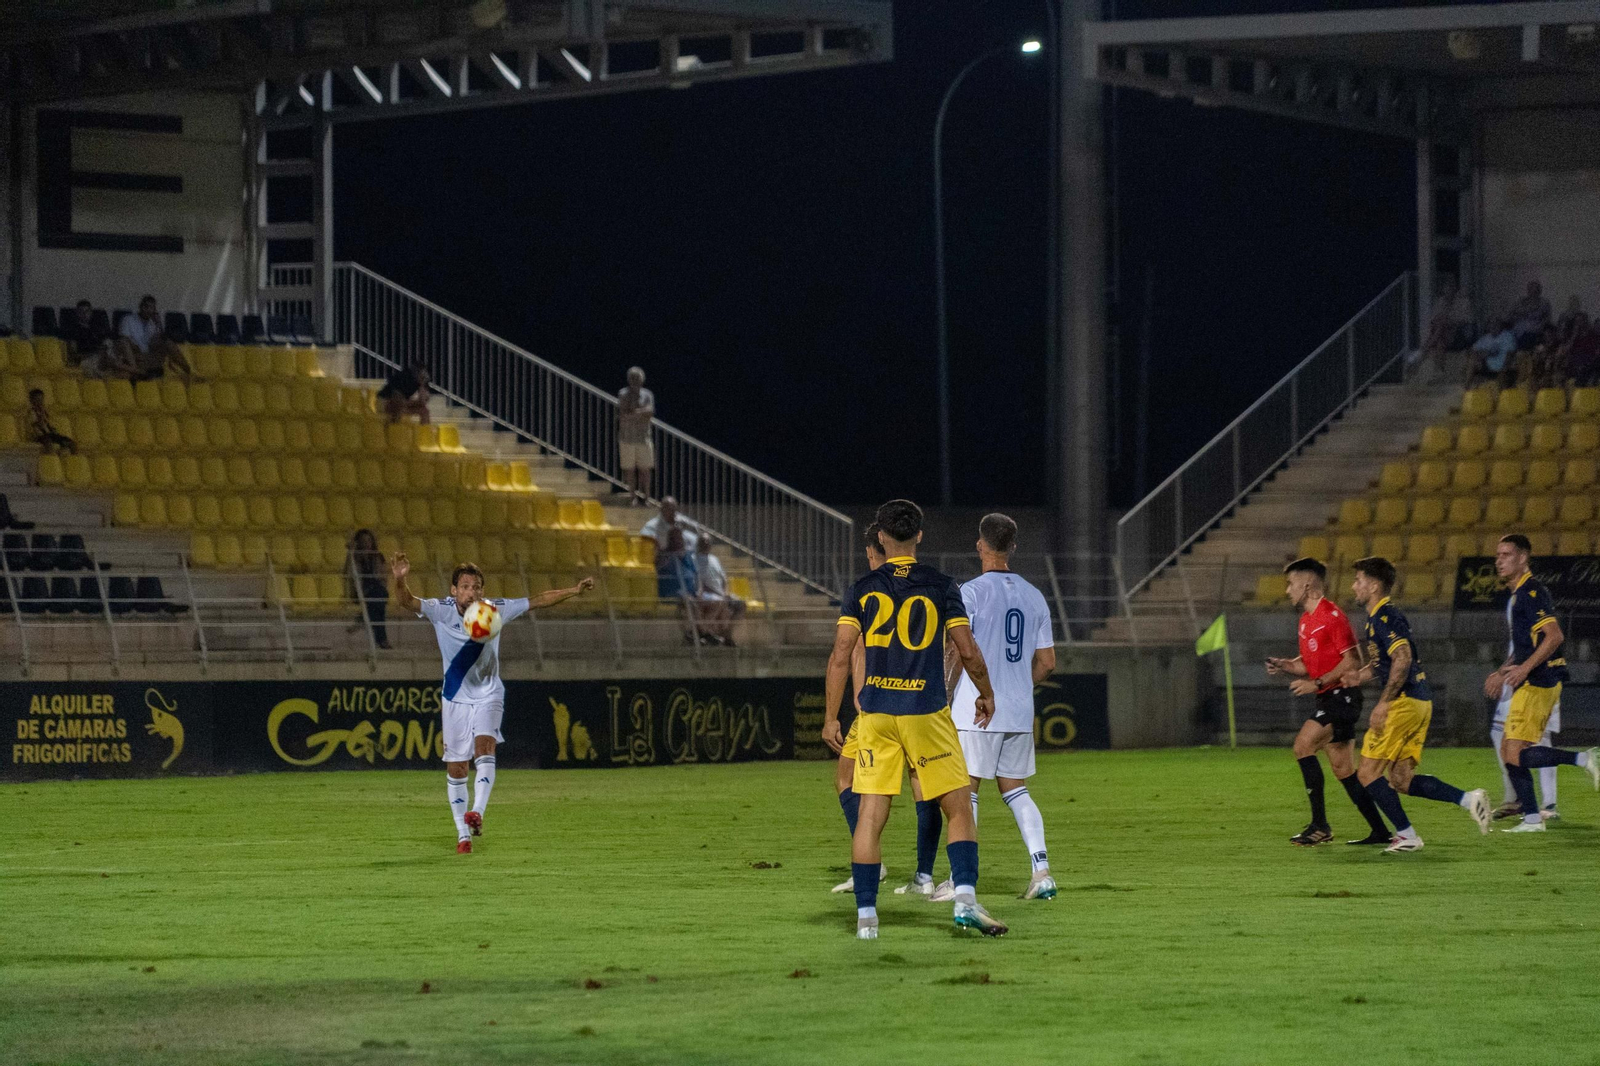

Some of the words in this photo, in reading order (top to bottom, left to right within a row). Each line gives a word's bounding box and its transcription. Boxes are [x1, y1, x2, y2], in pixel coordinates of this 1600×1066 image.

[37, 109, 184, 253] E
[859, 591, 938, 650] 20
[1005, 607, 1025, 662] 9
[866, 675, 926, 691] ARATRANS
[29, 694, 115, 714] ALQUILER
[327, 686, 442, 714] AUTOCARES
[17, 719, 40, 739] DE
[43, 713, 127, 739] CÁMARAS
[606, 686, 655, 764] La
[12, 738, 132, 763] FRIGORÍFICAS
